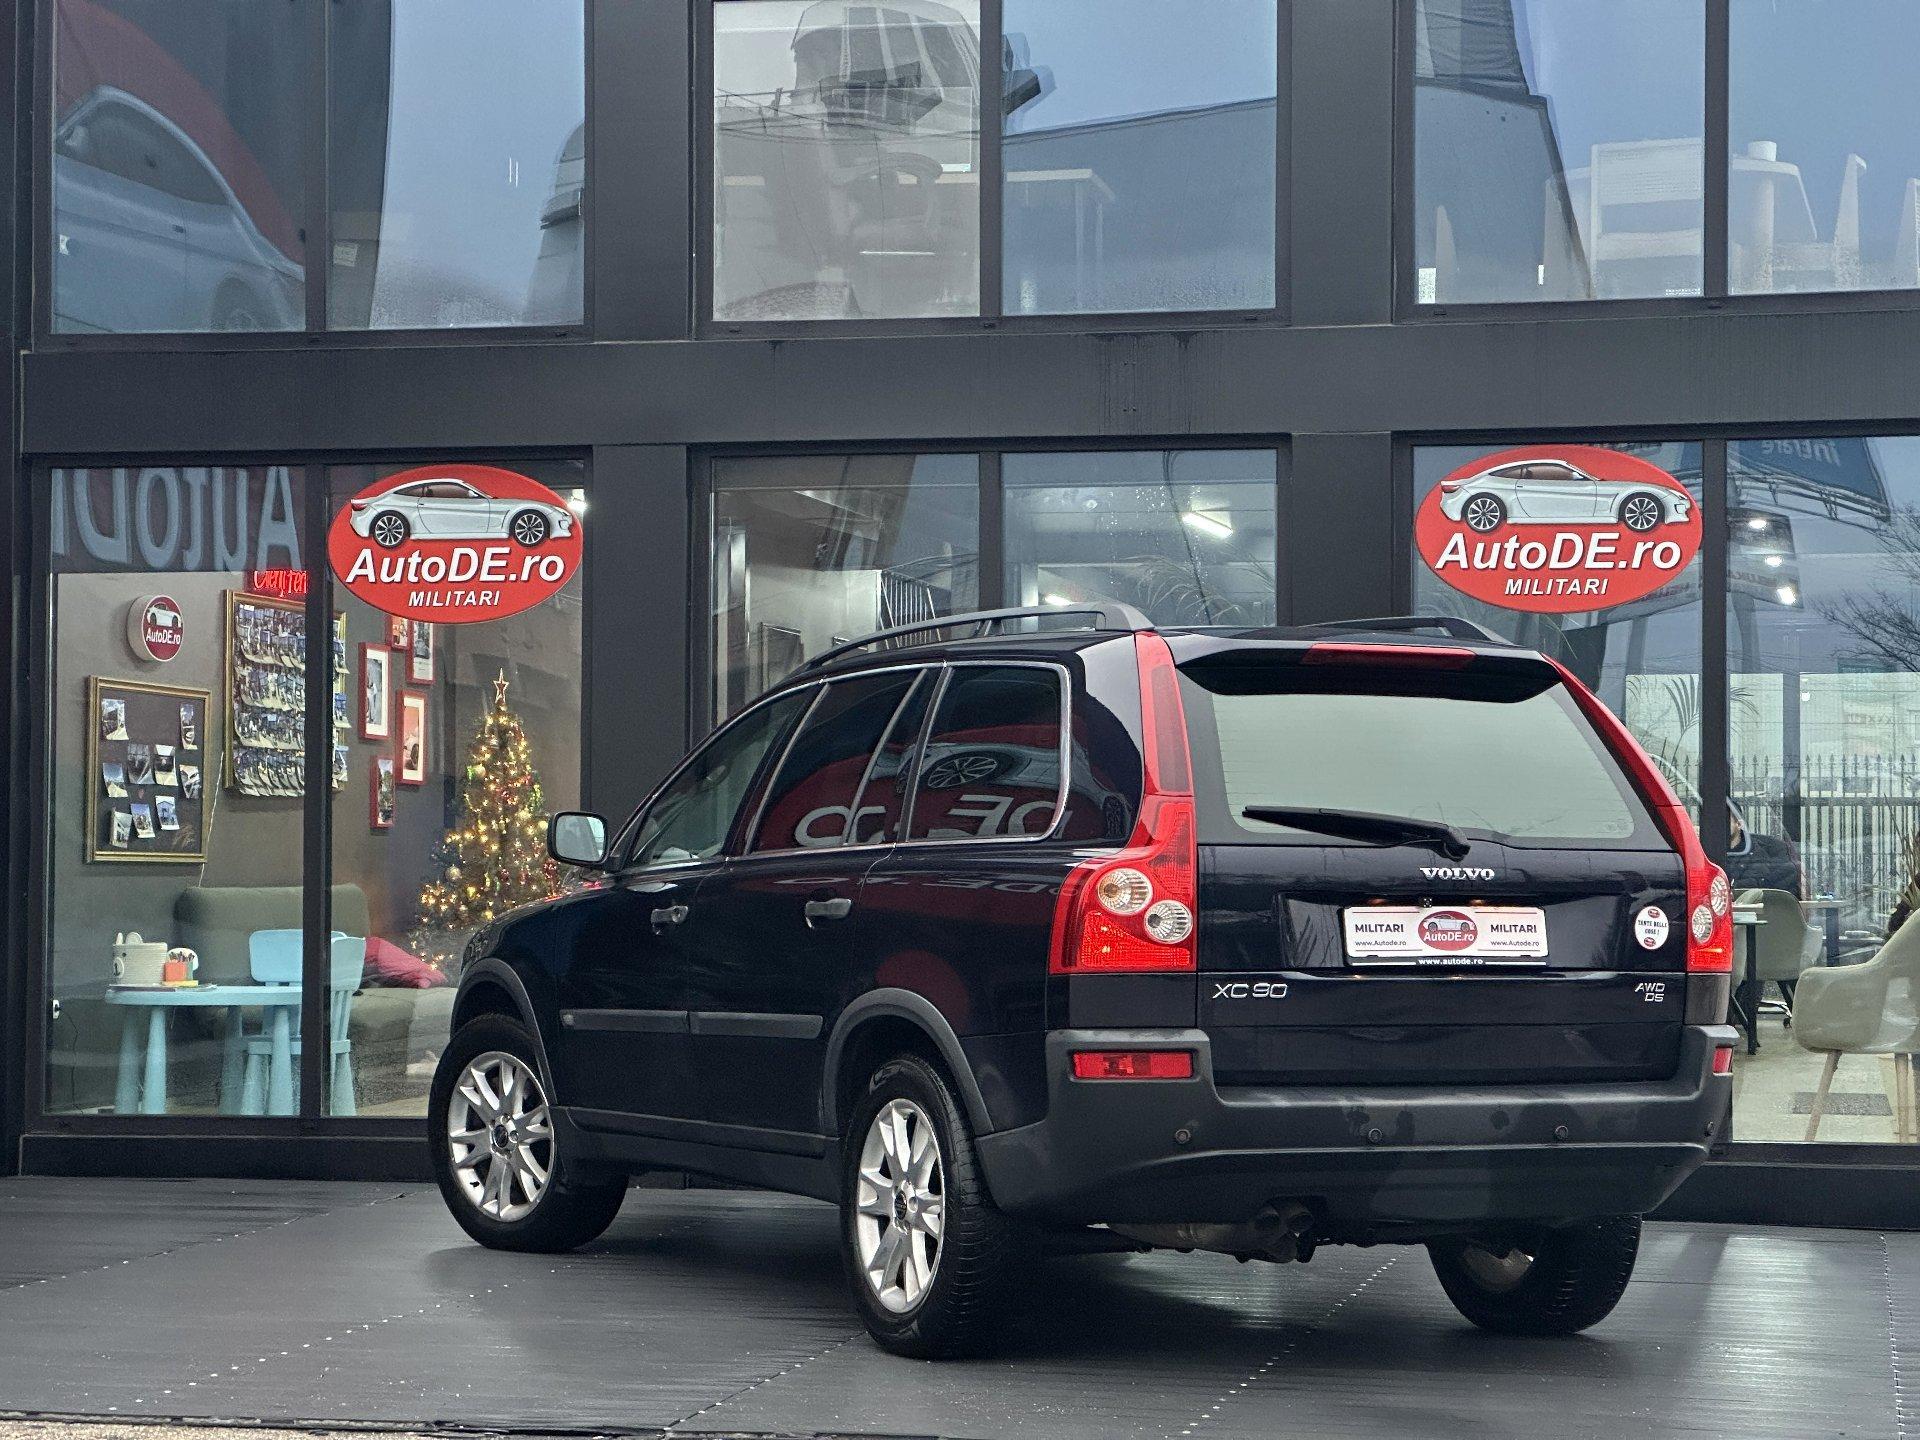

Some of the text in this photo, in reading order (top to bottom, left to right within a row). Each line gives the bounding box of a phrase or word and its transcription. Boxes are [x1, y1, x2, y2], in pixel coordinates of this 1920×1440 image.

[1434, 532, 1682, 569] AutoDE.ro
[345, 546, 565, 583] AutoDE.ro
[1504, 578, 1608, 595] MILITARI
[408, 590, 500, 607] MILITARI
[146, 627, 181, 645] AutoDE.ro
[1420, 867, 1495, 881] VOLVO
[1355, 923, 1404, 933] MILITARI
[1490, 924, 1537, 934] MILITARI
[1423, 931, 1475, 942] AutoDE.ro
[1418, 957, 1484, 966] www.autode.ro
[1634, 982, 1666, 992] AWD
[1644, 992, 1665, 1002] D5
